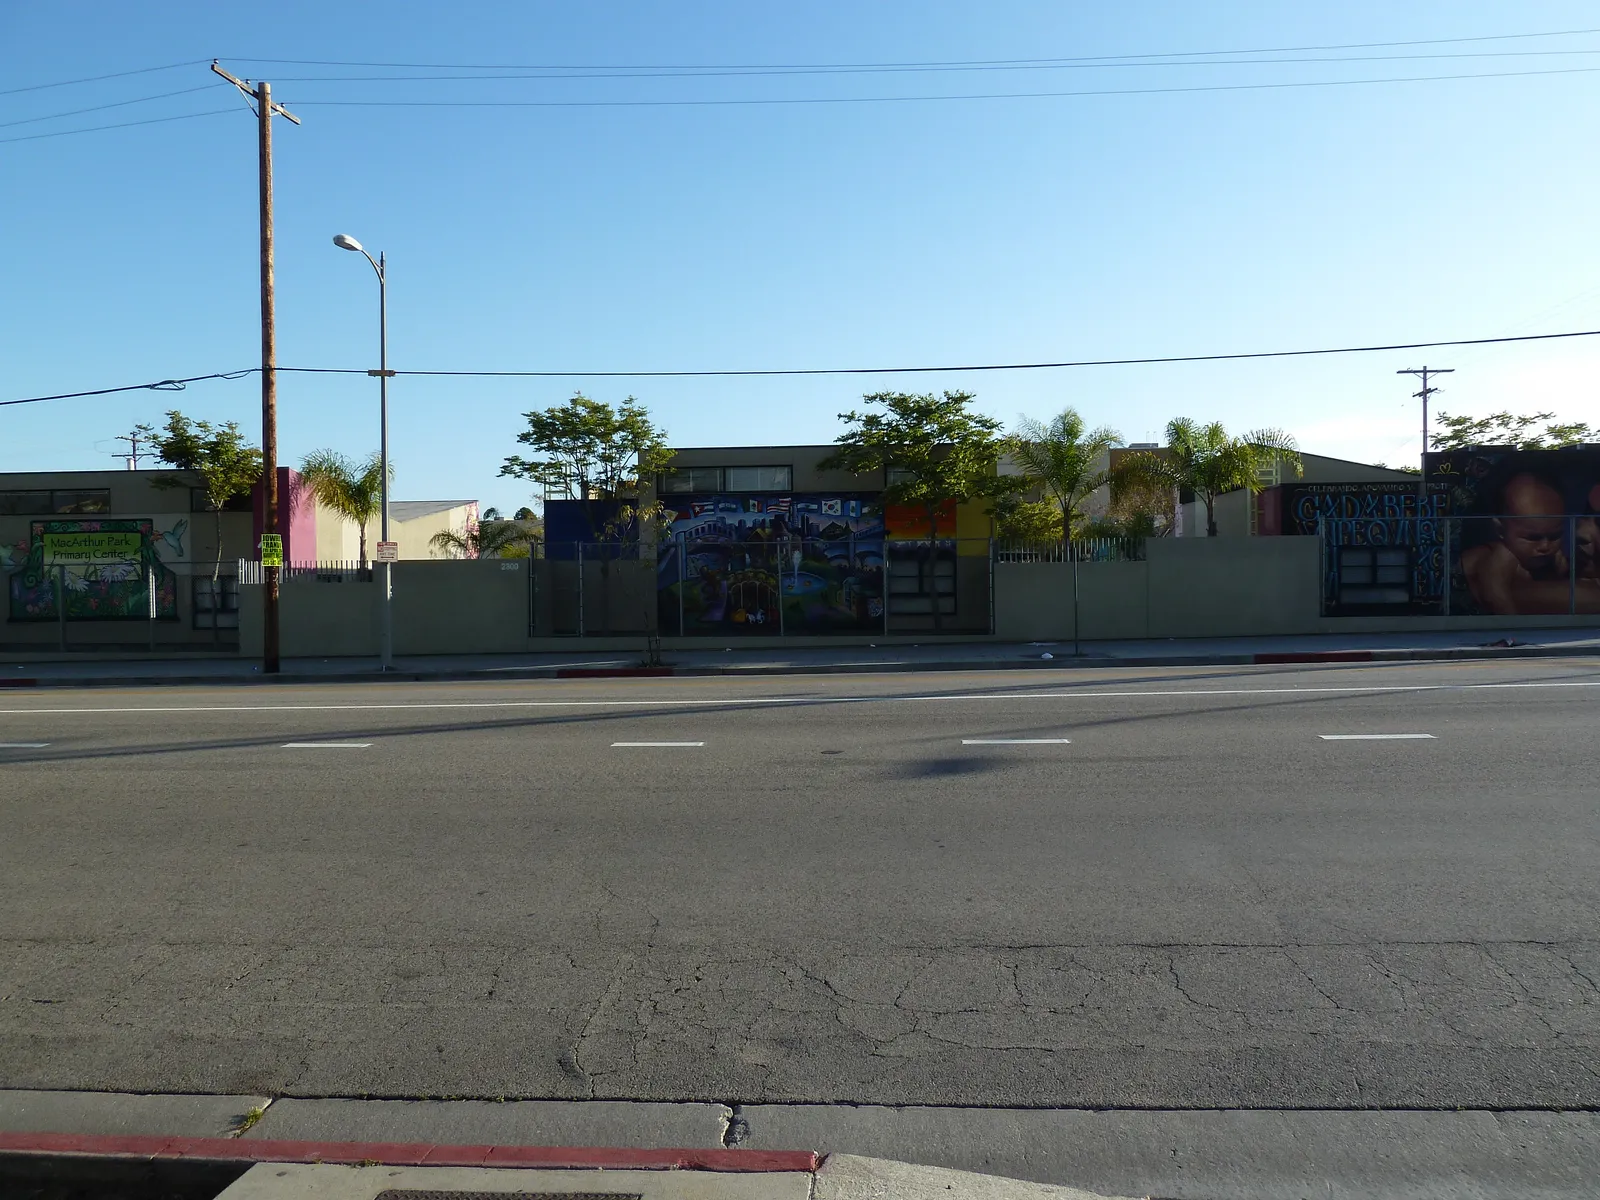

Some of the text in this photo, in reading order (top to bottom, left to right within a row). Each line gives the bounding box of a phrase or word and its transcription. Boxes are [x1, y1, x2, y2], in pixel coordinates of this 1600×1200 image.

[51, 534, 132, 548] MacArthur Park
[53, 549, 128, 563] Primary Center
